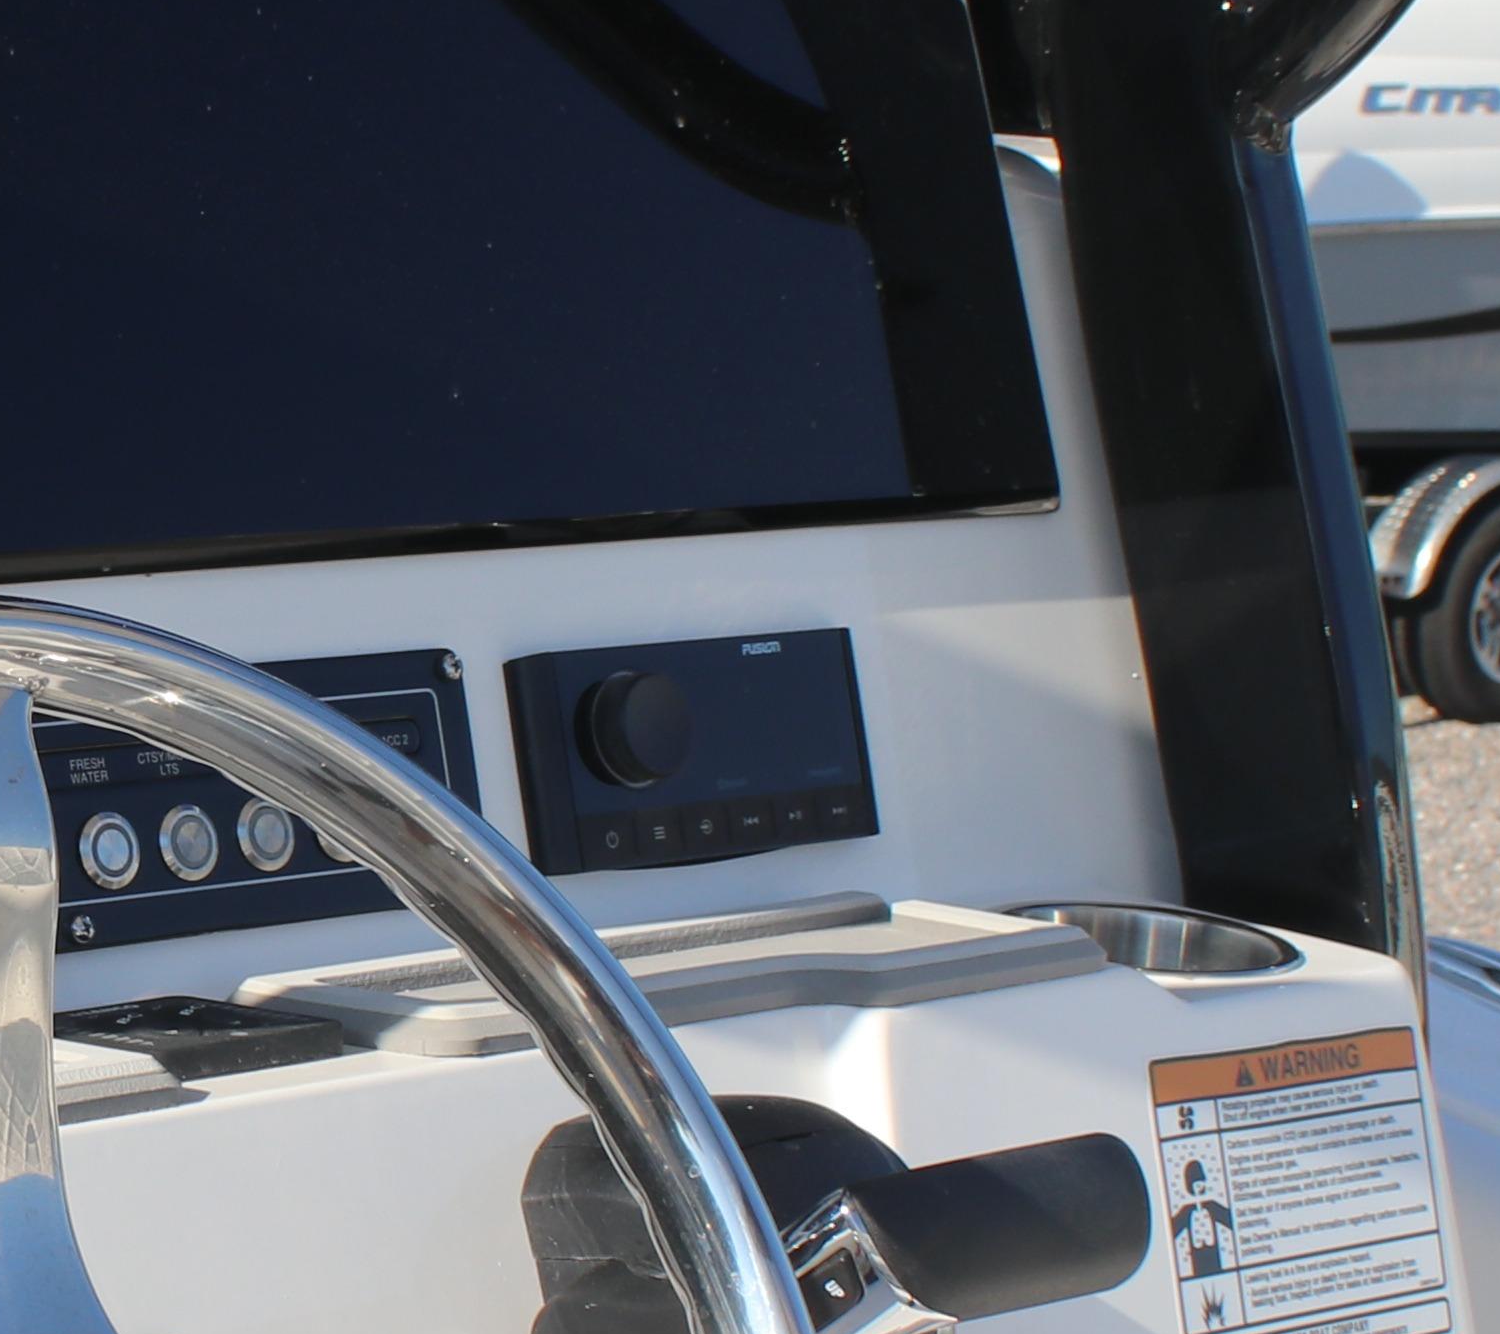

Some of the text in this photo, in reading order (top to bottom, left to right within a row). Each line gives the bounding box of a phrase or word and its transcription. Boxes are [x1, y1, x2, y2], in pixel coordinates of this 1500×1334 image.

[382, 734, 401, 747] CC
[69, 757, 106, 771] FRESH
[160, 763, 180, 776] LTS
[70, 770, 109, 785] WATER
[1258, 1043, 1361, 1083] WARNING
[824, 1279, 846, 1299] UP
